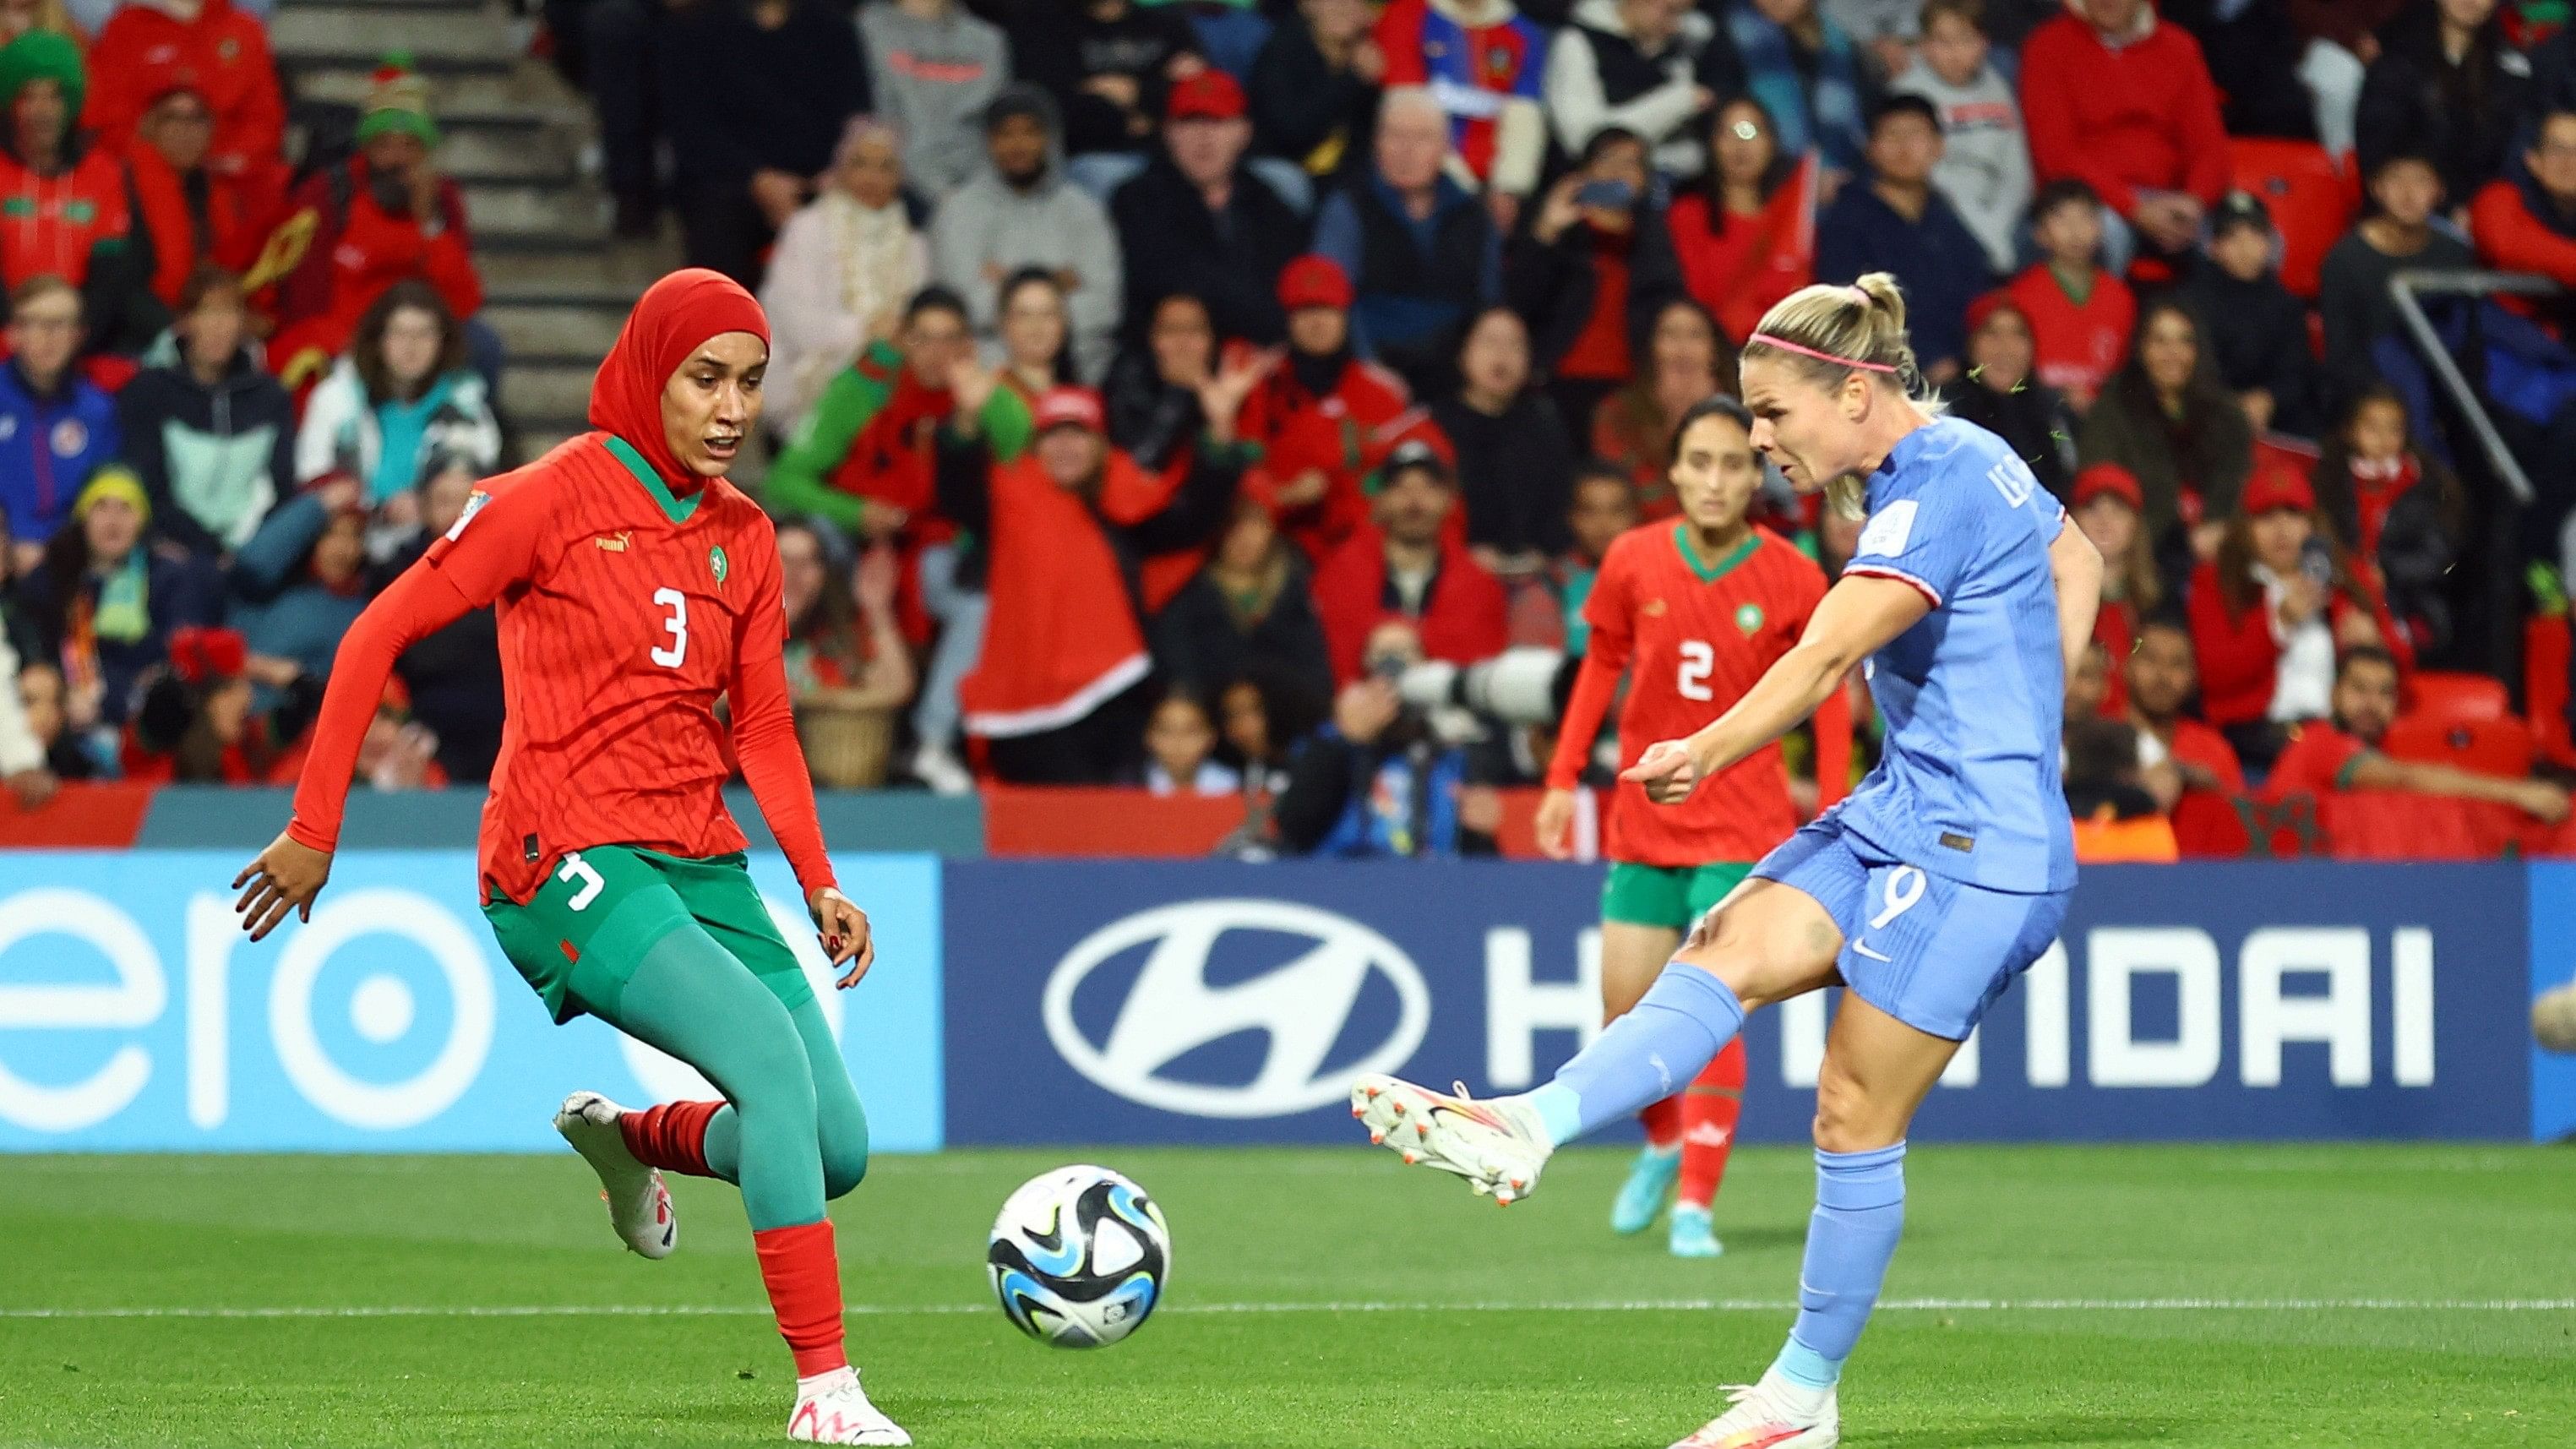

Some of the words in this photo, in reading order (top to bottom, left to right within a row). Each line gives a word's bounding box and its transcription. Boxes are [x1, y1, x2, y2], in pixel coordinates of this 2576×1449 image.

[650, 586, 688, 668] 3
[1676, 639, 1714, 702] 2
[558, 852, 606, 911] 3
[1869, 864, 1927, 930] 9
[1485, 923, 2435, 1089] HDAI
